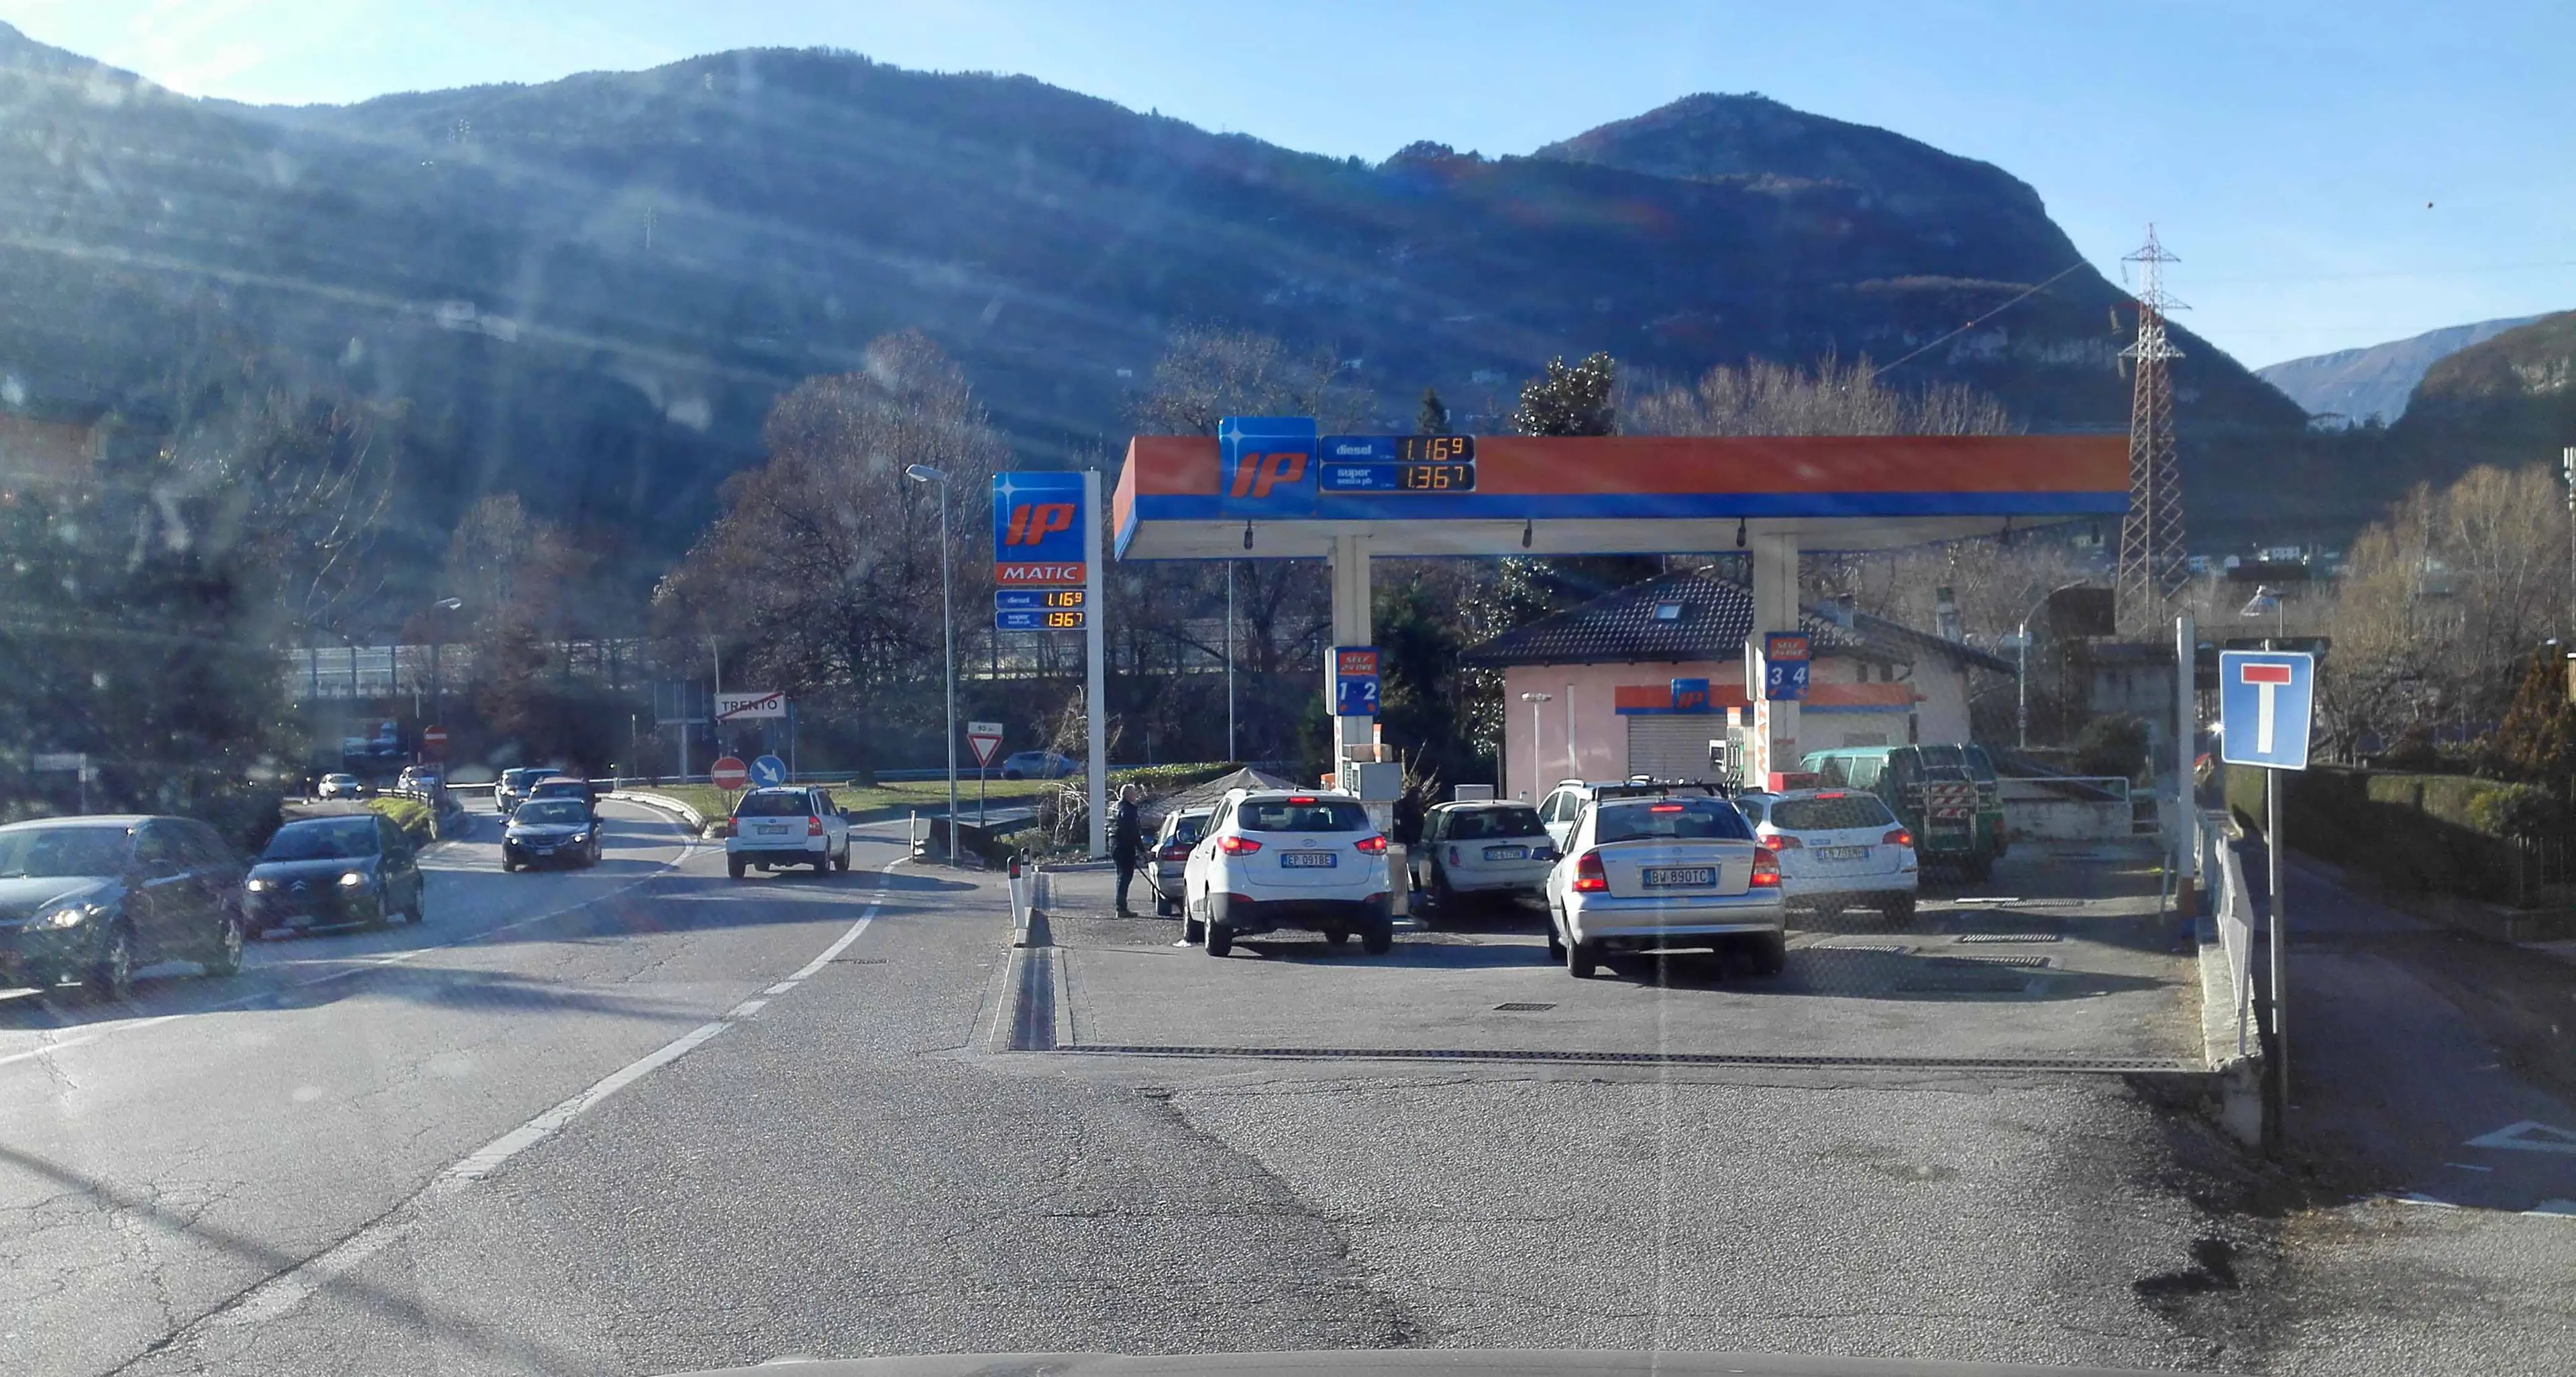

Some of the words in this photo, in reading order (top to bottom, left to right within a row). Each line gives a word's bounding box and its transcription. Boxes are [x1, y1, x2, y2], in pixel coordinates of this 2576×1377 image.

[1337, 444, 1372, 455] diesel
[1230, 452, 1308, 498] IP
[1337, 469, 1371, 478] super
[1004, 503, 1075, 545] IP
[1003, 567, 1077, 580] MATIC
[1770, 667, 1783, 685] 3
[1792, 667, 1806, 683] 4
[1340, 682, 1348, 700] 1
[1363, 681, 1377, 700] 2
[721, 700, 777, 711] TRENTO
[1288, 855, 1298, 865] EP
[1652, 871, 1666, 883] BW
[1671, 871, 1706, 882] 890TC
